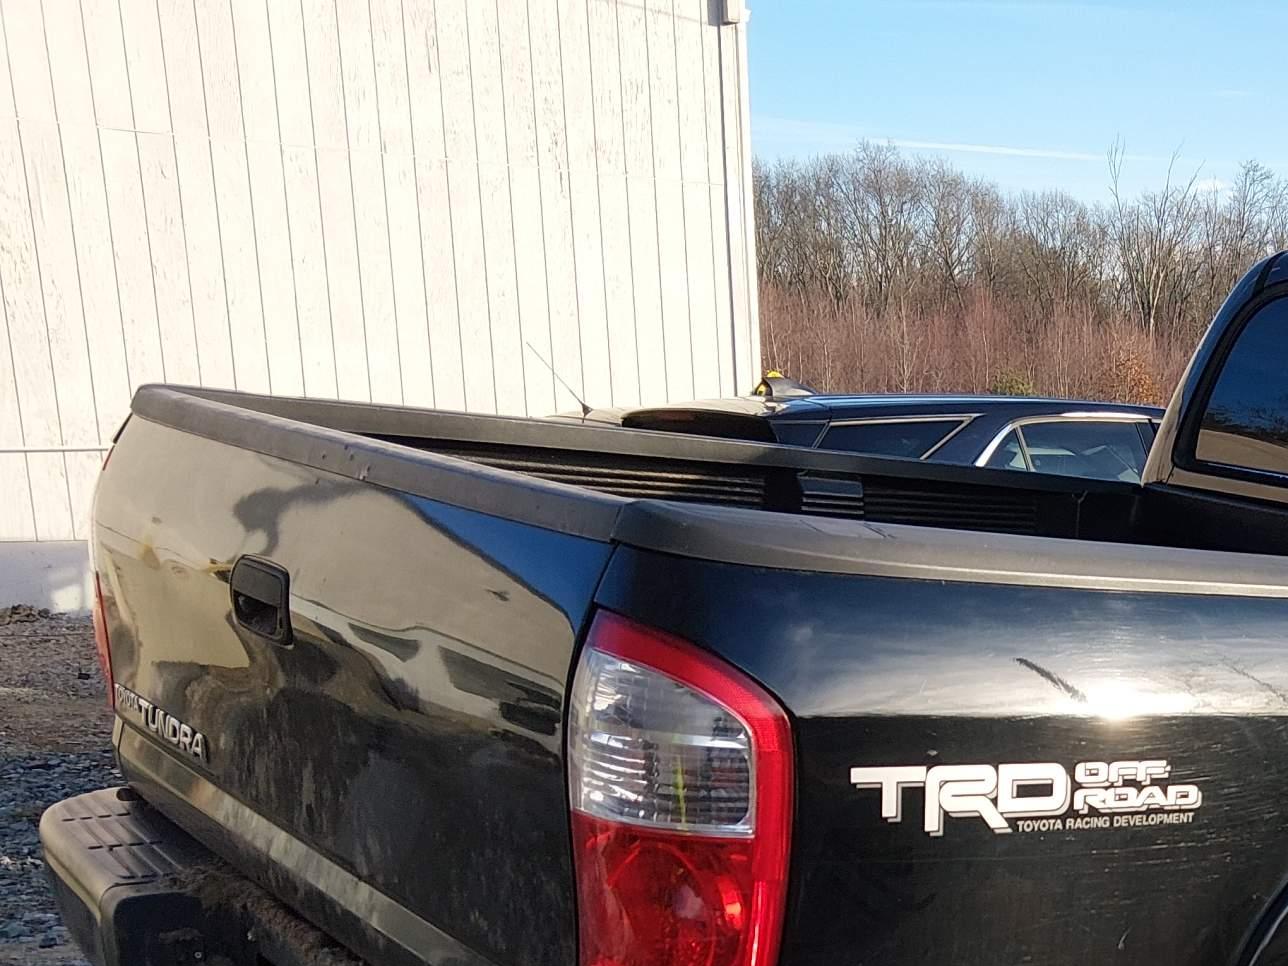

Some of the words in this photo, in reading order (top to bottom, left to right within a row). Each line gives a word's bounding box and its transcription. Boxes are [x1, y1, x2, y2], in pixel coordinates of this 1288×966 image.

[138, 697, 207, 761] TUNDRA
[1075, 760, 1171, 787] OFF
[851, 763, 1071, 836] TRD
[1073, 785, 1202, 814] ROAD
[1017, 819, 1063, 832] TOYOTA
[1066, 816, 1110, 830] RACING
[1113, 812, 1195, 828] DEVELOPMENT
